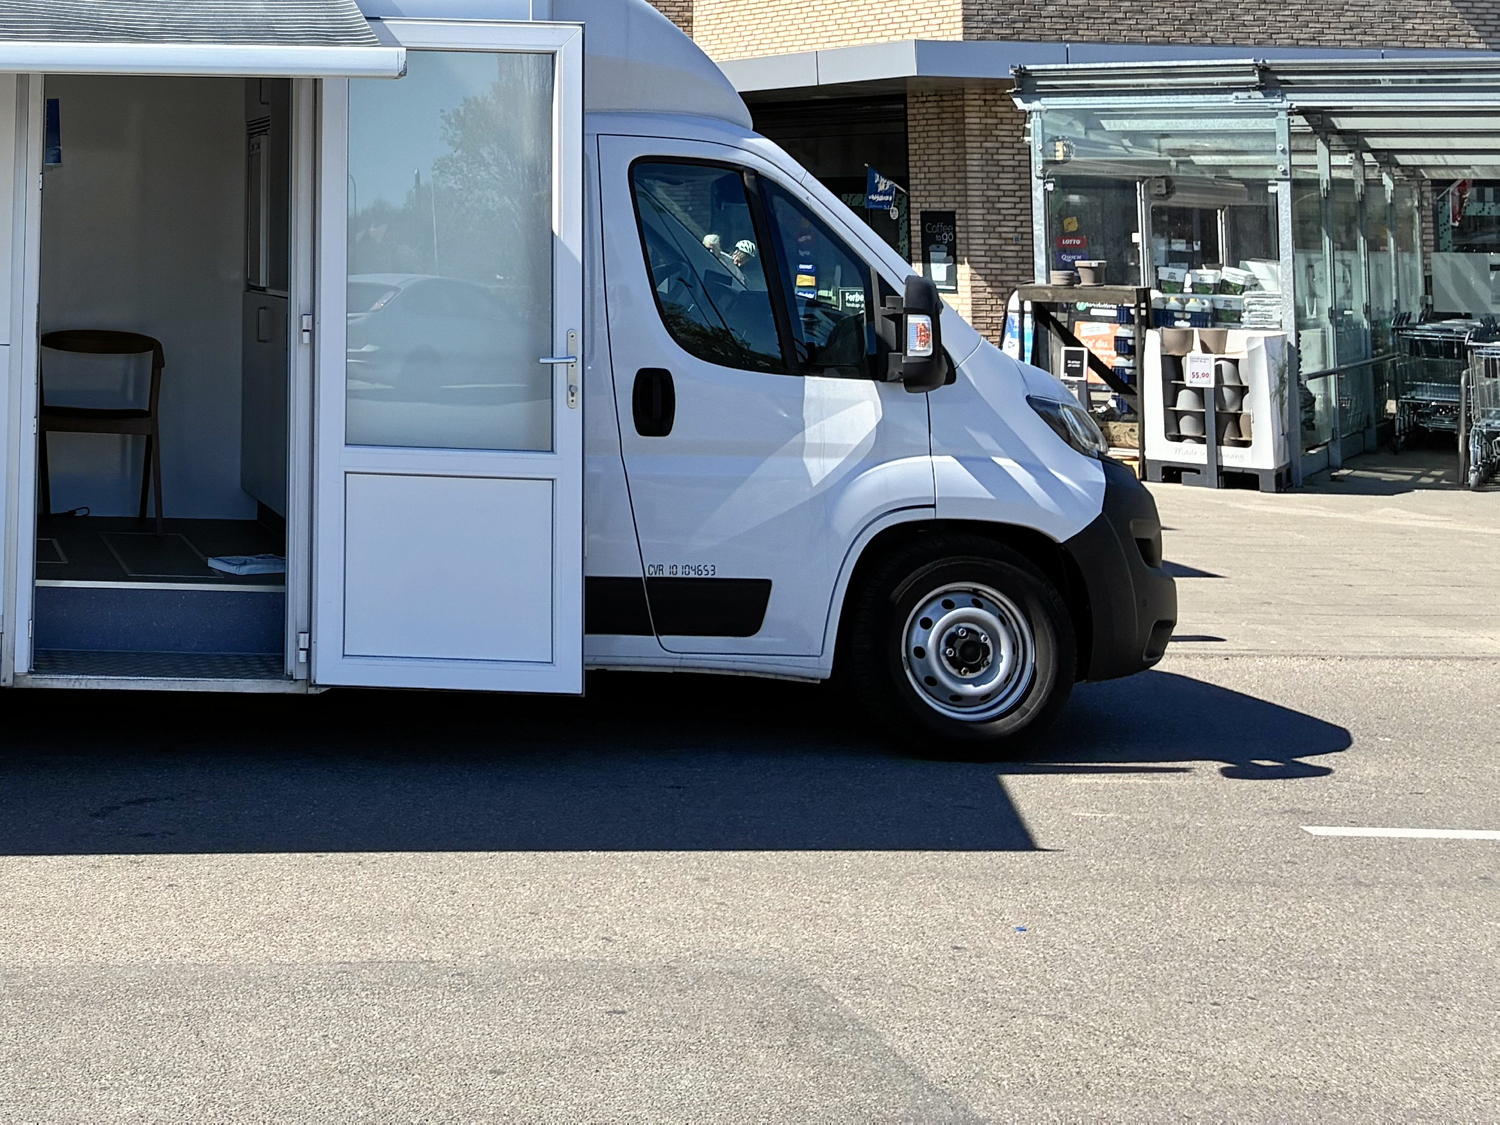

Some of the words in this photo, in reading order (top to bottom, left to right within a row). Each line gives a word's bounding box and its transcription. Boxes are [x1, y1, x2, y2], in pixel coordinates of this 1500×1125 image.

[925, 222, 953, 234] Coffee
[941, 232, 954, 244] go
[648, 564, 664, 576] CVR
